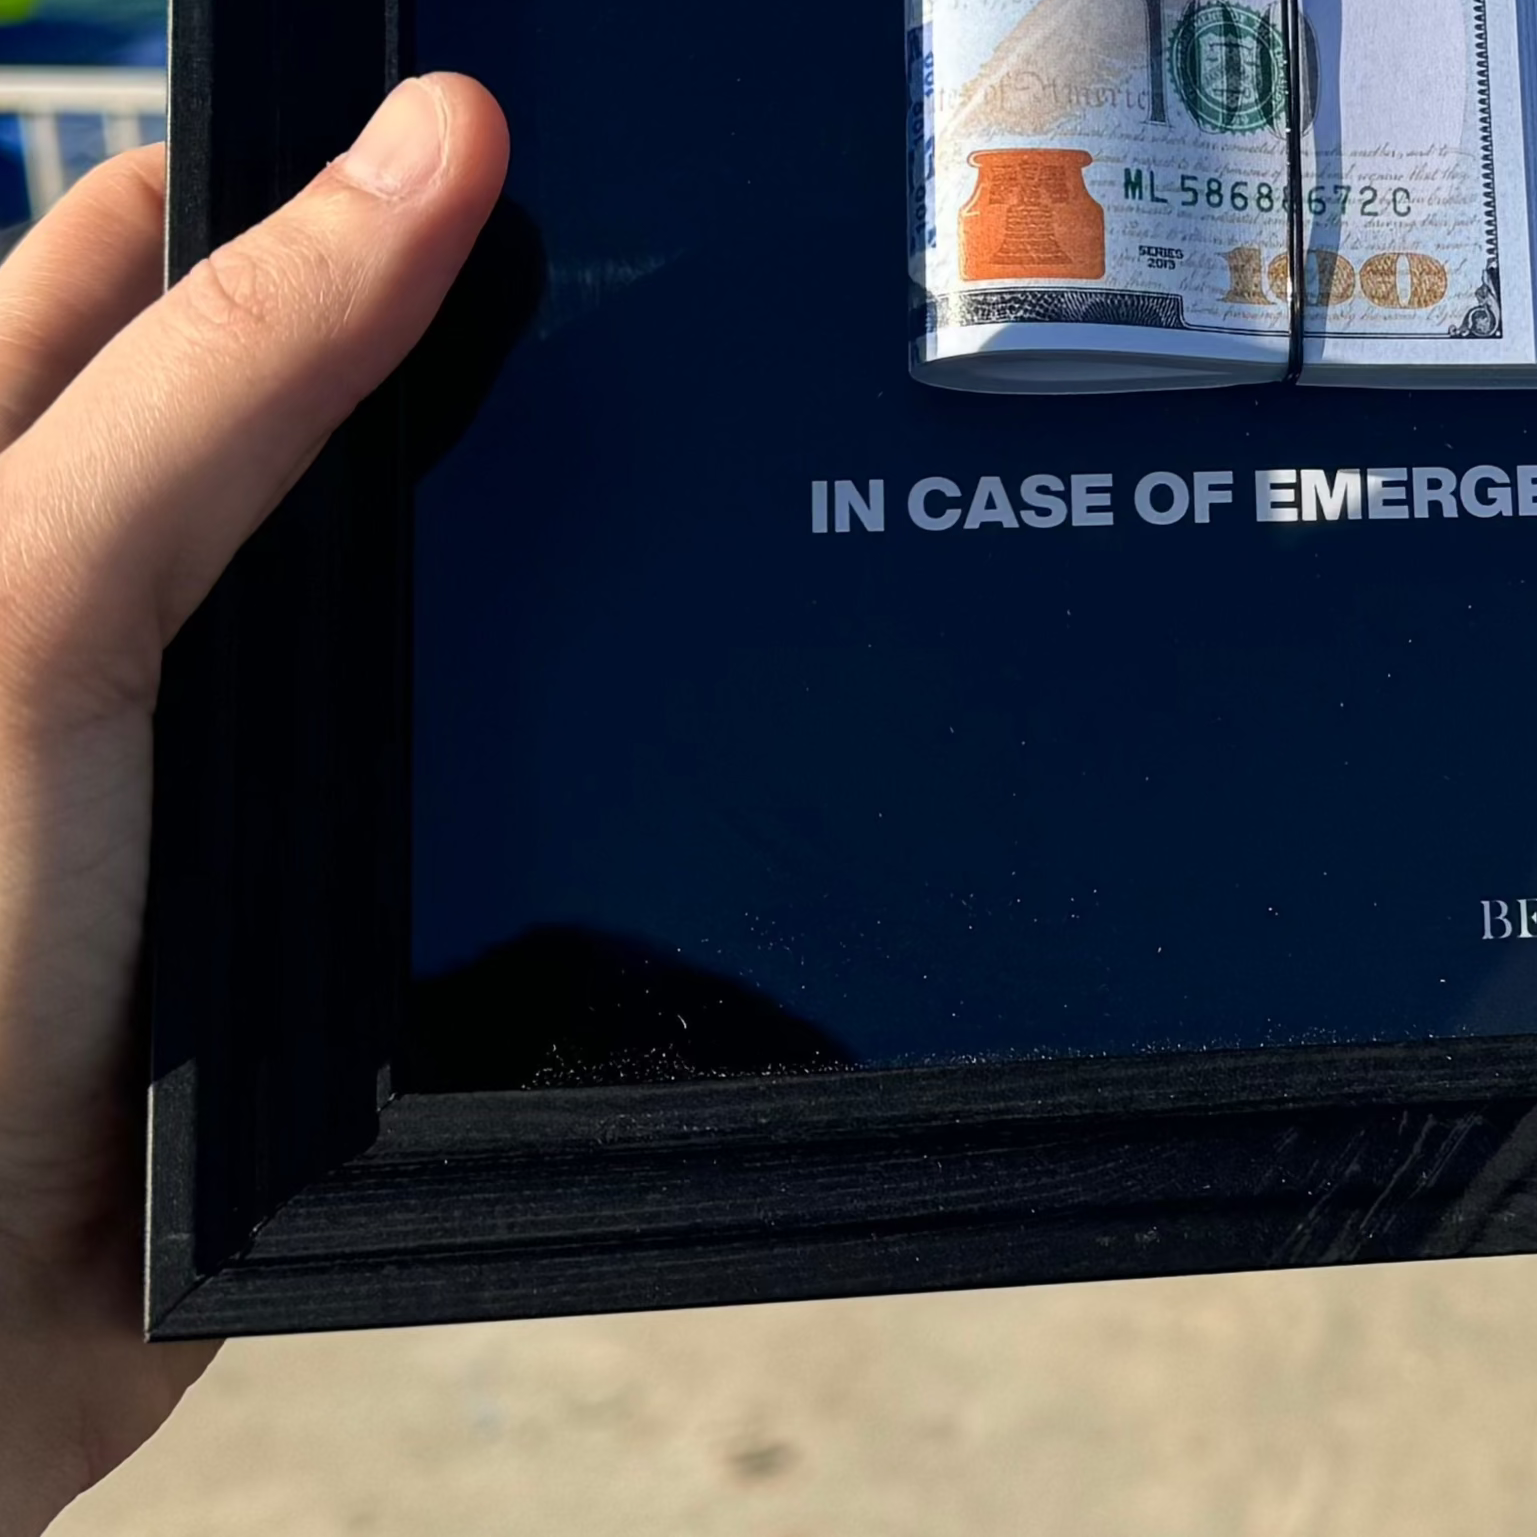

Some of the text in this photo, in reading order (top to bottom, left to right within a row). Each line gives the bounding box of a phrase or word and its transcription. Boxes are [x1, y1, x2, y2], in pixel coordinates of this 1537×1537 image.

[1138, 244, 1184, 260] SERIES
[1215, 246, 1448, 309] 100
[811, 478, 885, 533] IN
[907, 473, 1114, 531] CASE
[1133, 470, 1234, 525] OF
